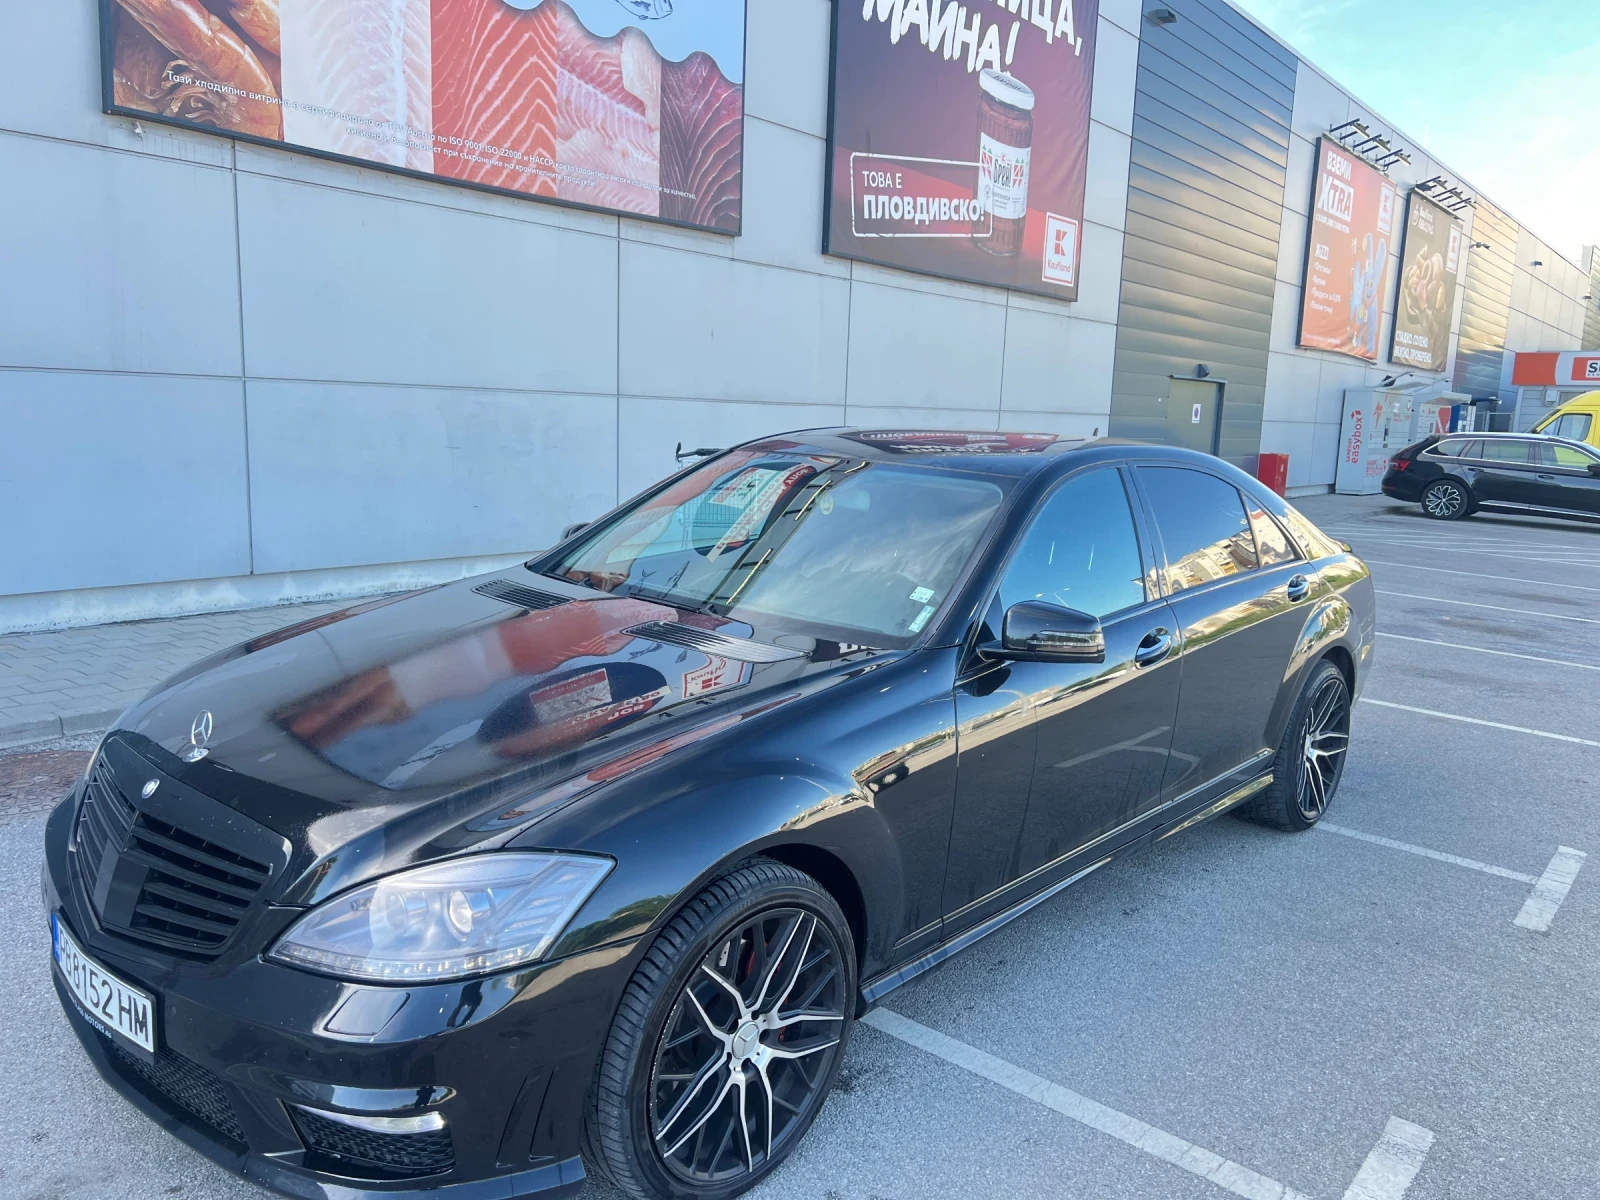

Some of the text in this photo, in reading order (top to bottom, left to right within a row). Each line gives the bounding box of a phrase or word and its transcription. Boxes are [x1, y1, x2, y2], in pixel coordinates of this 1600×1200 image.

[167, 70, 192, 85] Тази
[195, 79, 246, 98] хладилна
[249, 92, 290, 106] витрина
[301, 104, 374, 126] сертифицирана
[376, 121, 386, 129] от
[407, 126, 436, 141] Austria
[449, 137, 463, 146] ISO
[485, 144, 498, 154] ISO
[500, 148, 522, 160] 22000
[555, 163, 575, 173] което
[575, 167, 609, 180] гарантира
[610, 175, 631, 184] високи
[670, 189, 697, 200] качество,
[346, 127, 382, 140] хигиена
[391, 136, 442, 154] безопасност
[443, 149, 459, 158] при
[459, 153, 503, 168] съхранение
[504, 162, 514, 170] на
[515, 165, 562, 180] хранителните
[1326, 150, 1352, 181] ВЗЕМИ
[862, 170, 902, 189] ТОВА Е
[863, 194, 985, 225] ПЛОВДИВСКО!
[1047, 259, 1071, 273] Kaufland
[1351, 417, 1363, 464] easybox
[84, 1012, 105, 1034] MOTORS
